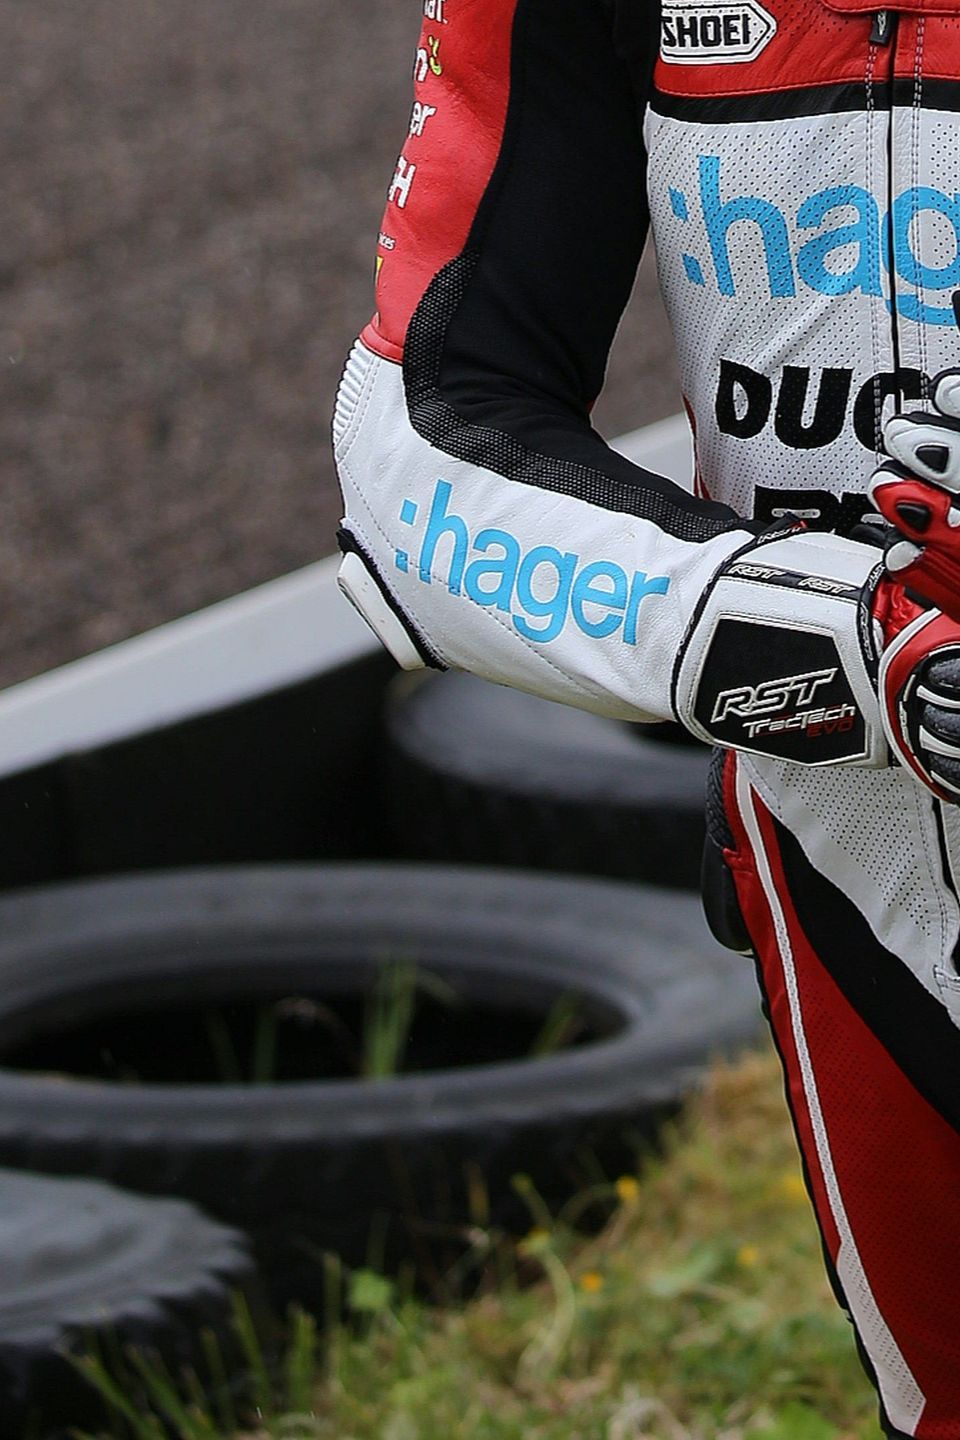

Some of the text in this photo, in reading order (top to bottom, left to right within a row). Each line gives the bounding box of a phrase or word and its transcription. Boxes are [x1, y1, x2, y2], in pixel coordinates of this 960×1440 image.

[660, 13, 751, 47] SHOEI
[728, 563, 787, 580] RST
[798, 576, 857, 594] RST
[710, 667, 839, 723] RST
